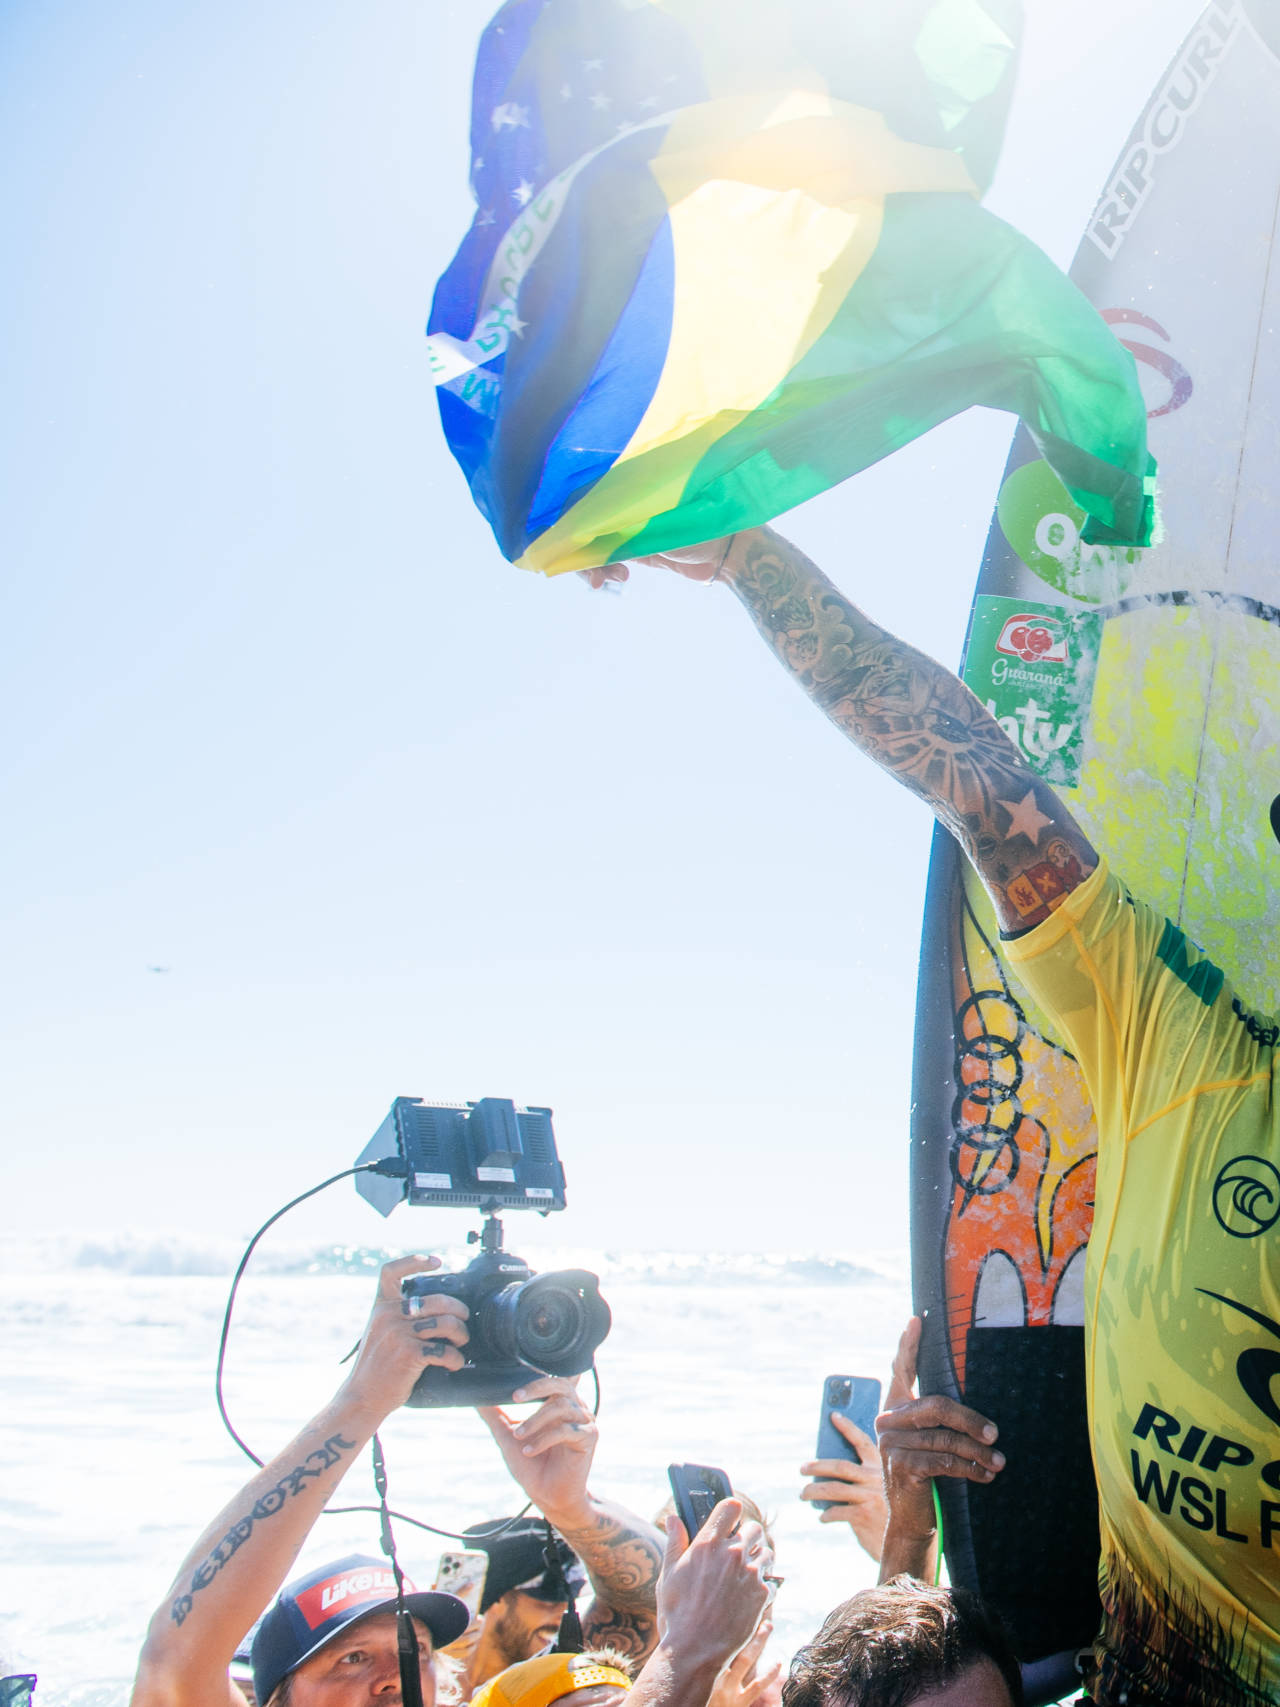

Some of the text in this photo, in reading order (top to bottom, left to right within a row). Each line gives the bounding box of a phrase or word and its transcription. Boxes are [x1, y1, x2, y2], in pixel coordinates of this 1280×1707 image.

[1089, 10, 1241, 255] RIP CURL
[1132, 1402, 1255, 1473] RIP
[1130, 1448, 1249, 1545] WSL
